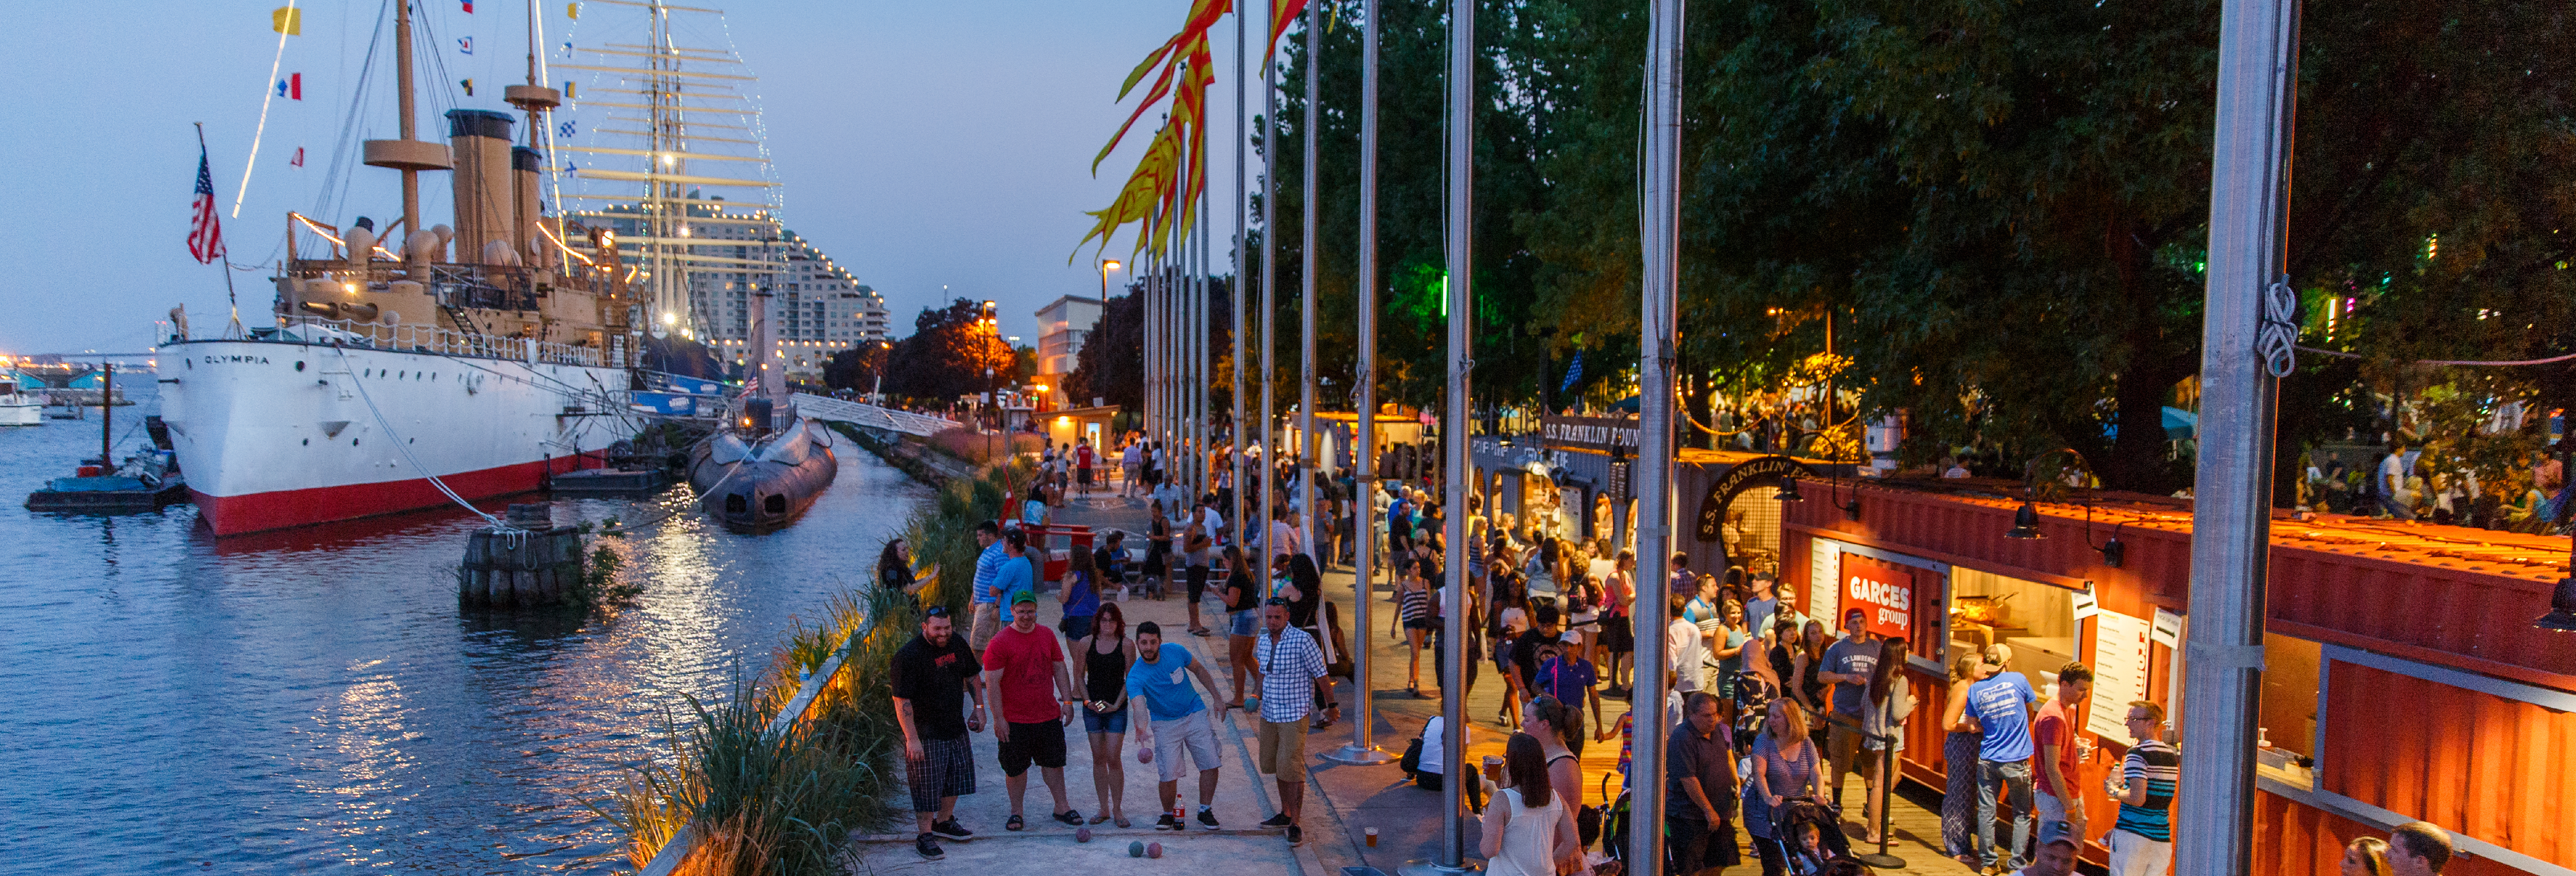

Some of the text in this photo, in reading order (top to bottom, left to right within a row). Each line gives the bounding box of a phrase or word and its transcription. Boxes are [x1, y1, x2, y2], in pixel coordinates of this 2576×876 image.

[205, 355, 270, 364] OLYMPIA
[1546, 423, 1640, 447] S.S. FRANKLIN FOUN
[1703, 461, 1787, 534] S.S. FRANKLIN
[1850, 576, 1910, 610] GARCES
[1878, 607, 1908, 631] group
